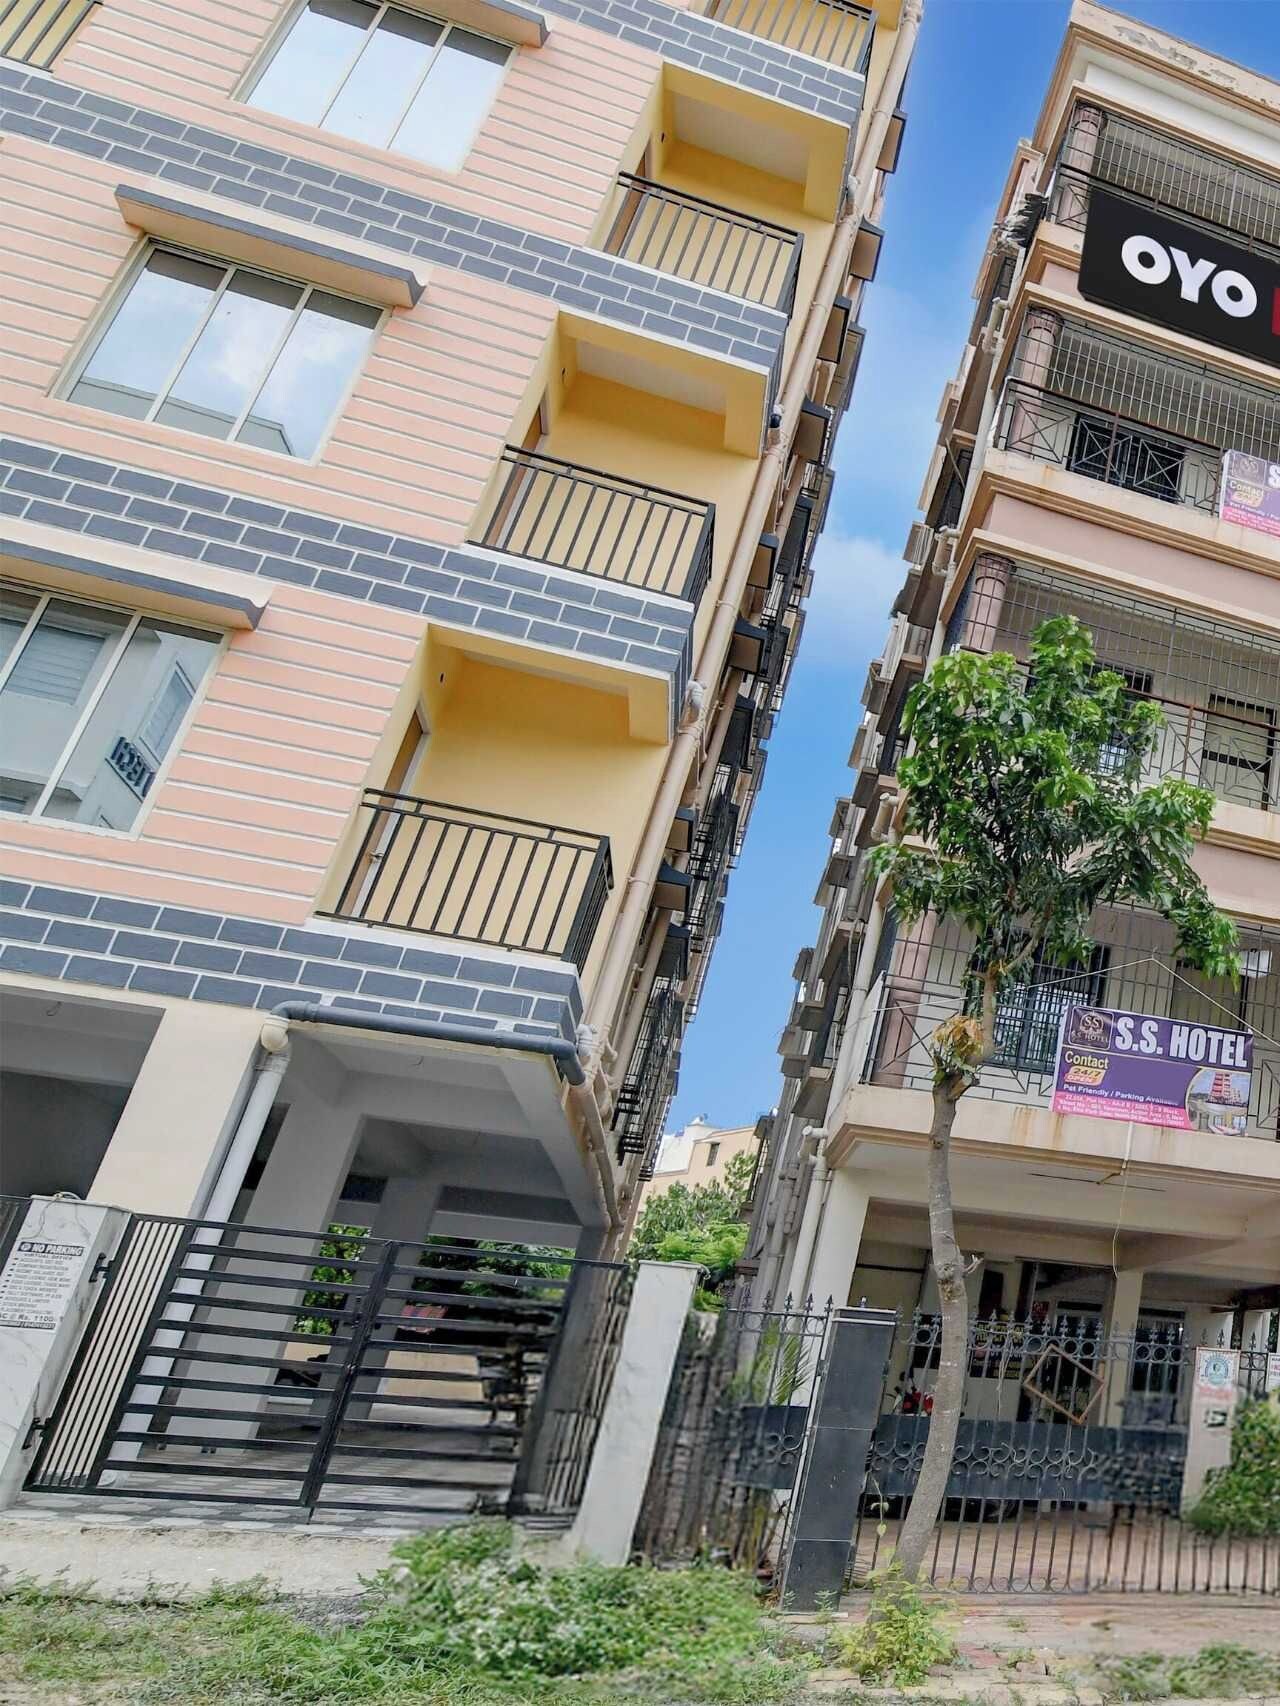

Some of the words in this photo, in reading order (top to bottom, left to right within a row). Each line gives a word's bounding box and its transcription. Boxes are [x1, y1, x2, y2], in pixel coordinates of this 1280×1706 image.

[1121, 235, 1258, 318] OYO
[1115, 1017, 1163, 1055] S.S.
[1170, 1024, 1247, 1067] HOTEL
[1065, 1051, 1109, 1070] Contact
[1073, 1067, 1101, 1078] 24/7
[1063, 1083, 1076, 1092] Pet
[1077, 1085, 1108, 1097] Friendly
[1115, 1091, 1144, 1103] Parking
[31, 1244, 46, 1253] NO
[46, 1246, 83, 1256] PARKING
